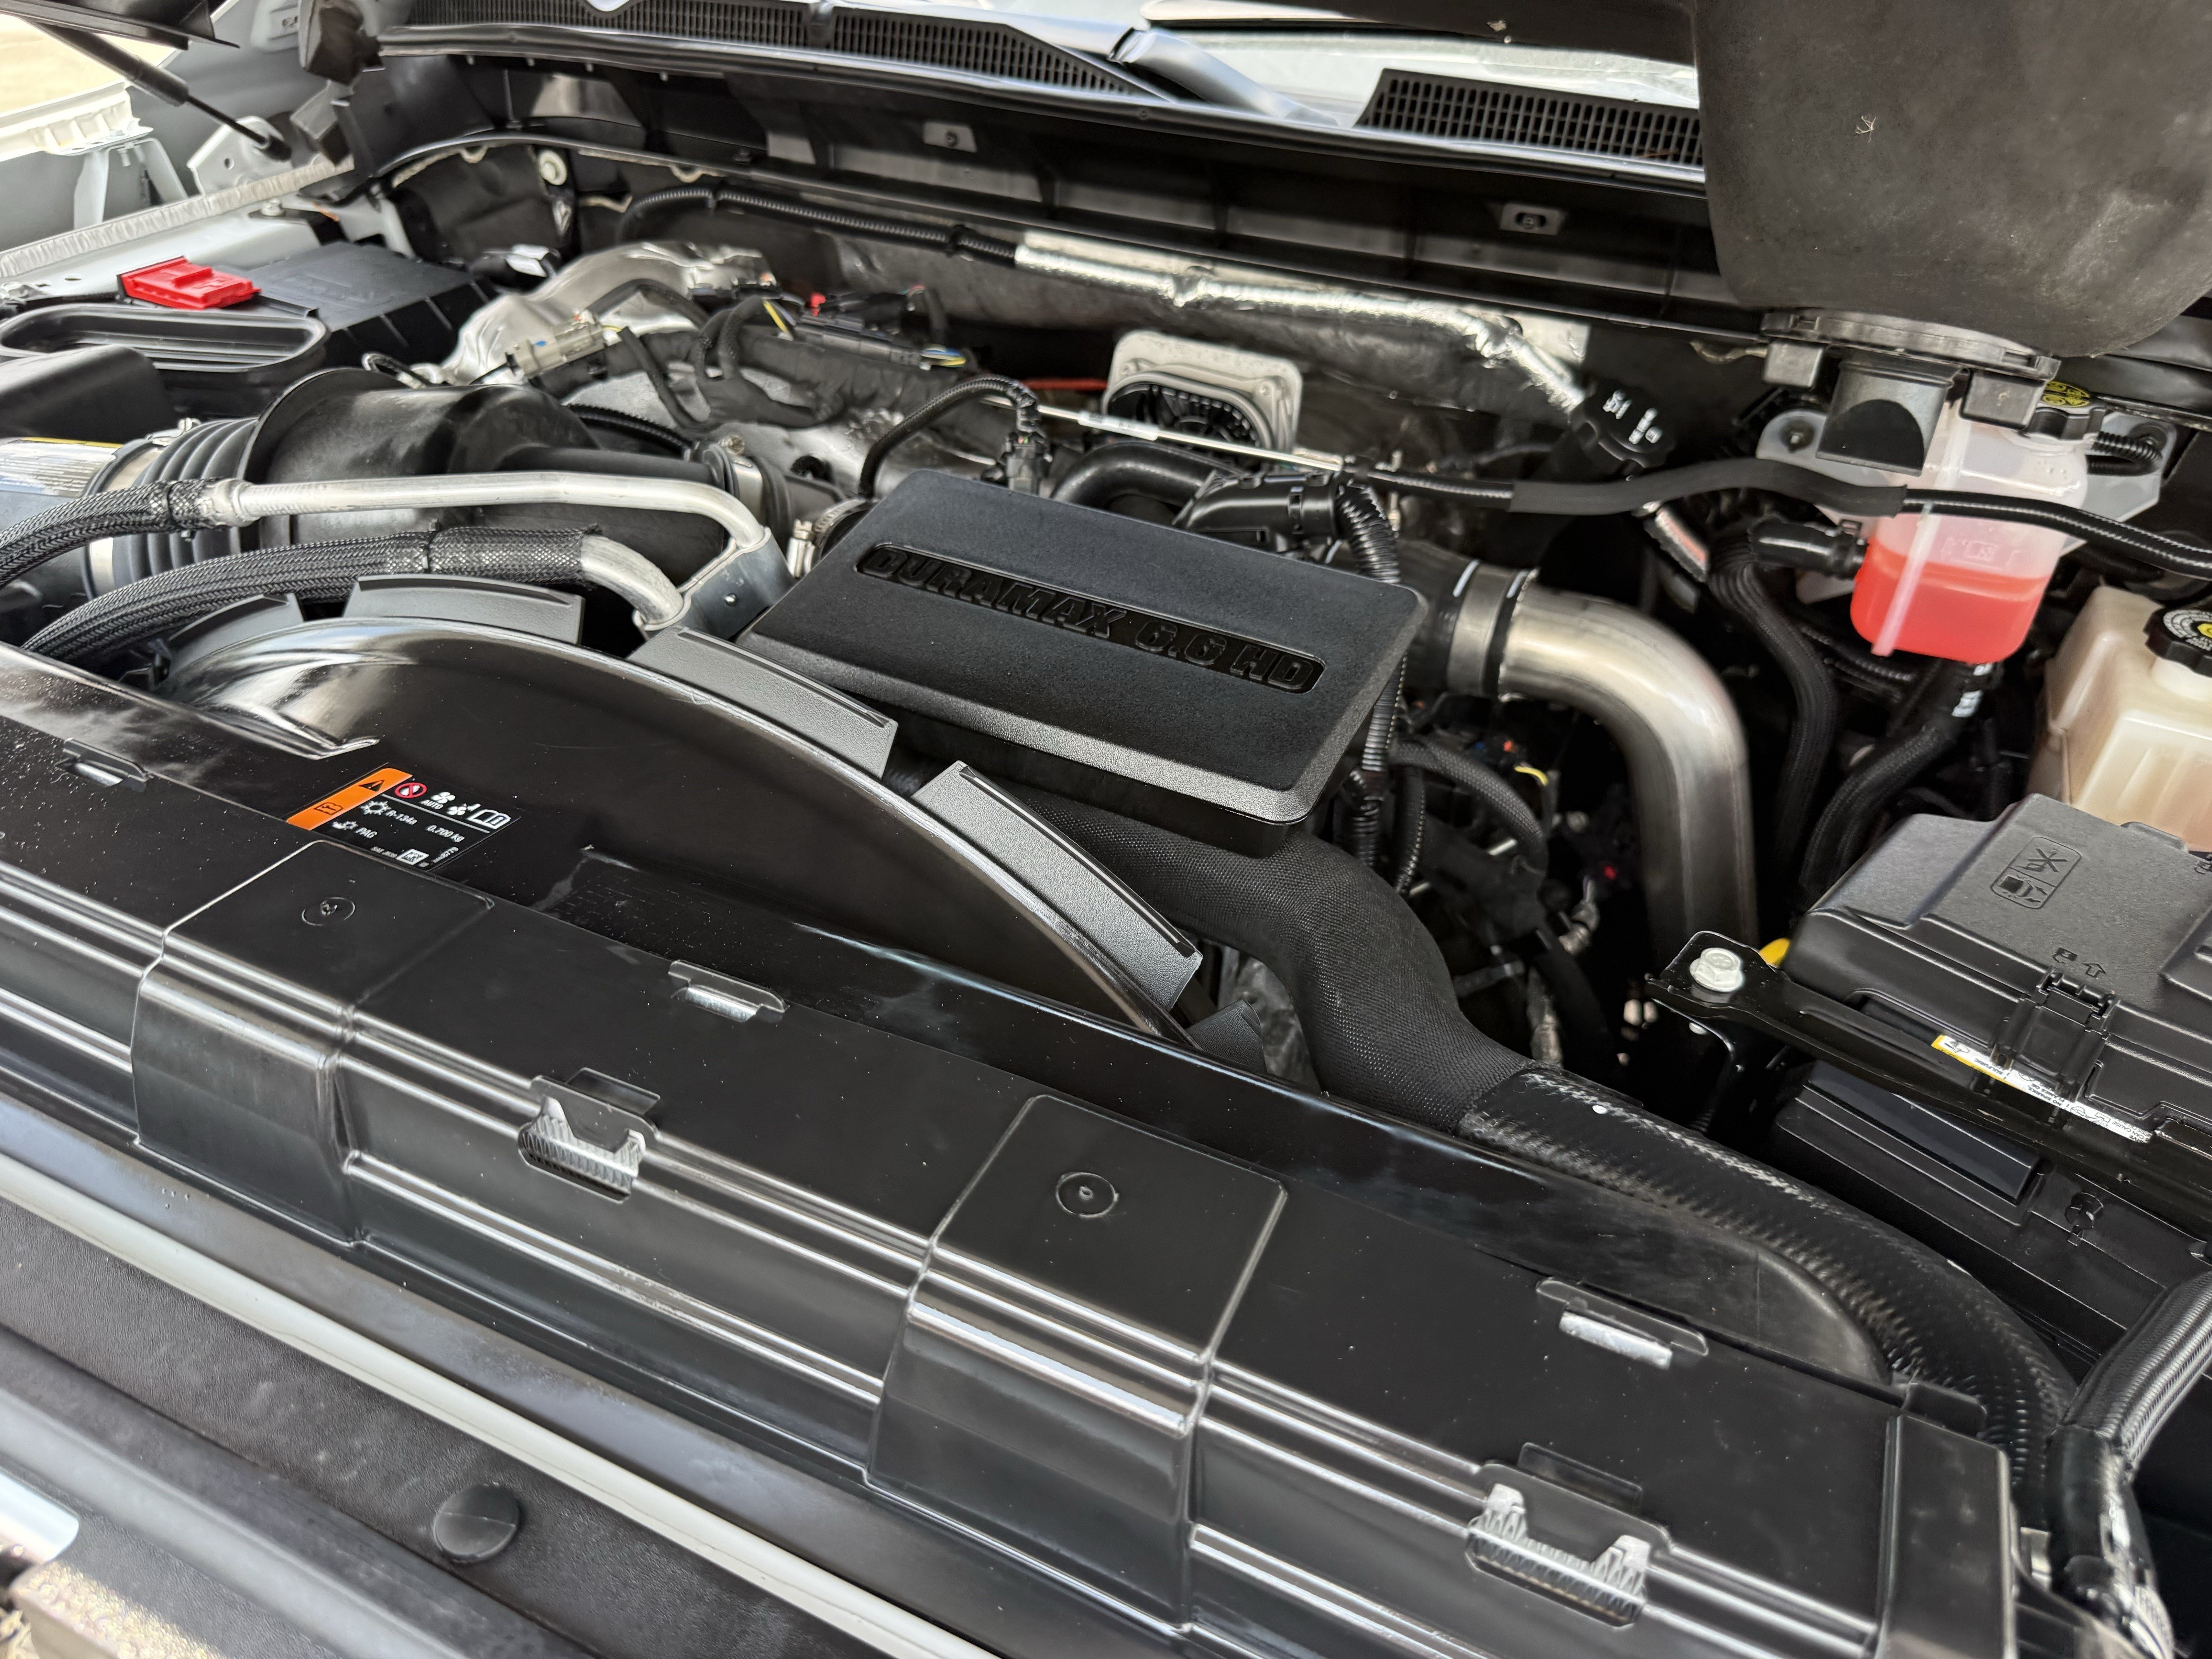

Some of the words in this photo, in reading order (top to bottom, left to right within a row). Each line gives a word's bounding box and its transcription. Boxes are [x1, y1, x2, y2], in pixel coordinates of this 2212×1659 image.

[862, 548, 1126, 638] DURAMAX
[1134, 621, 1228, 665] 6.6
[1230, 646, 1314, 690] HD
[420, 799, 444, 809] AUTO
[386, 810, 418, 825] R-134a
[426, 825, 454, 837] 0.700
[355, 827, 378, 839] PAG
[1974, 1058, 2003, 1075] SULFURIC
[2111, 1121, 2131, 1132] CAUSE
